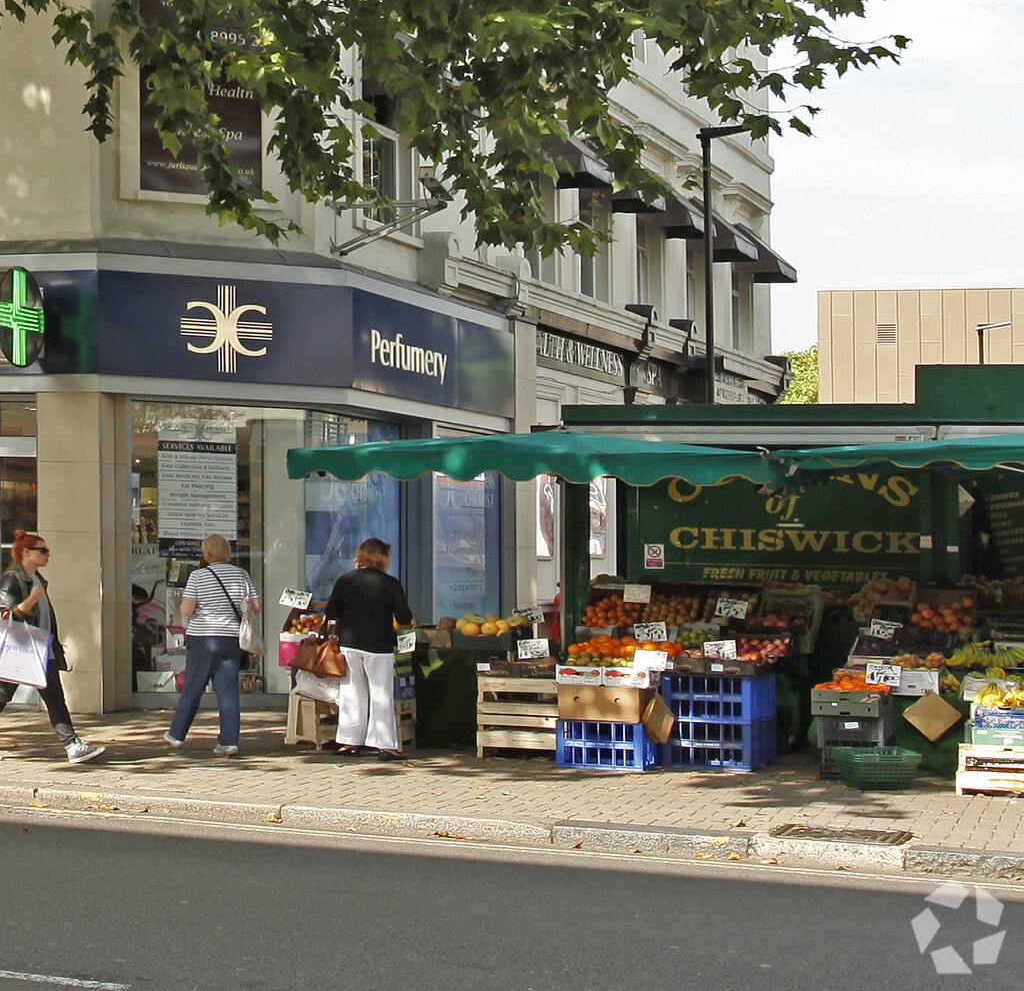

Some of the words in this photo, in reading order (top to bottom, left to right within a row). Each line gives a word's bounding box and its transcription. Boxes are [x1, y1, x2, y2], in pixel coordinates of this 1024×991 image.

[371, 329, 448, 385] Perfumery
[162, 442, 194, 451] SERVICES
[196, 444, 233, 453] AVAILABLE
[669, 526, 921, 554] CHISWICK
[703, 567, 745, 580] FRESH
[749, 568, 788, 581] FRUIT
[790, 569, 800, 581] &
